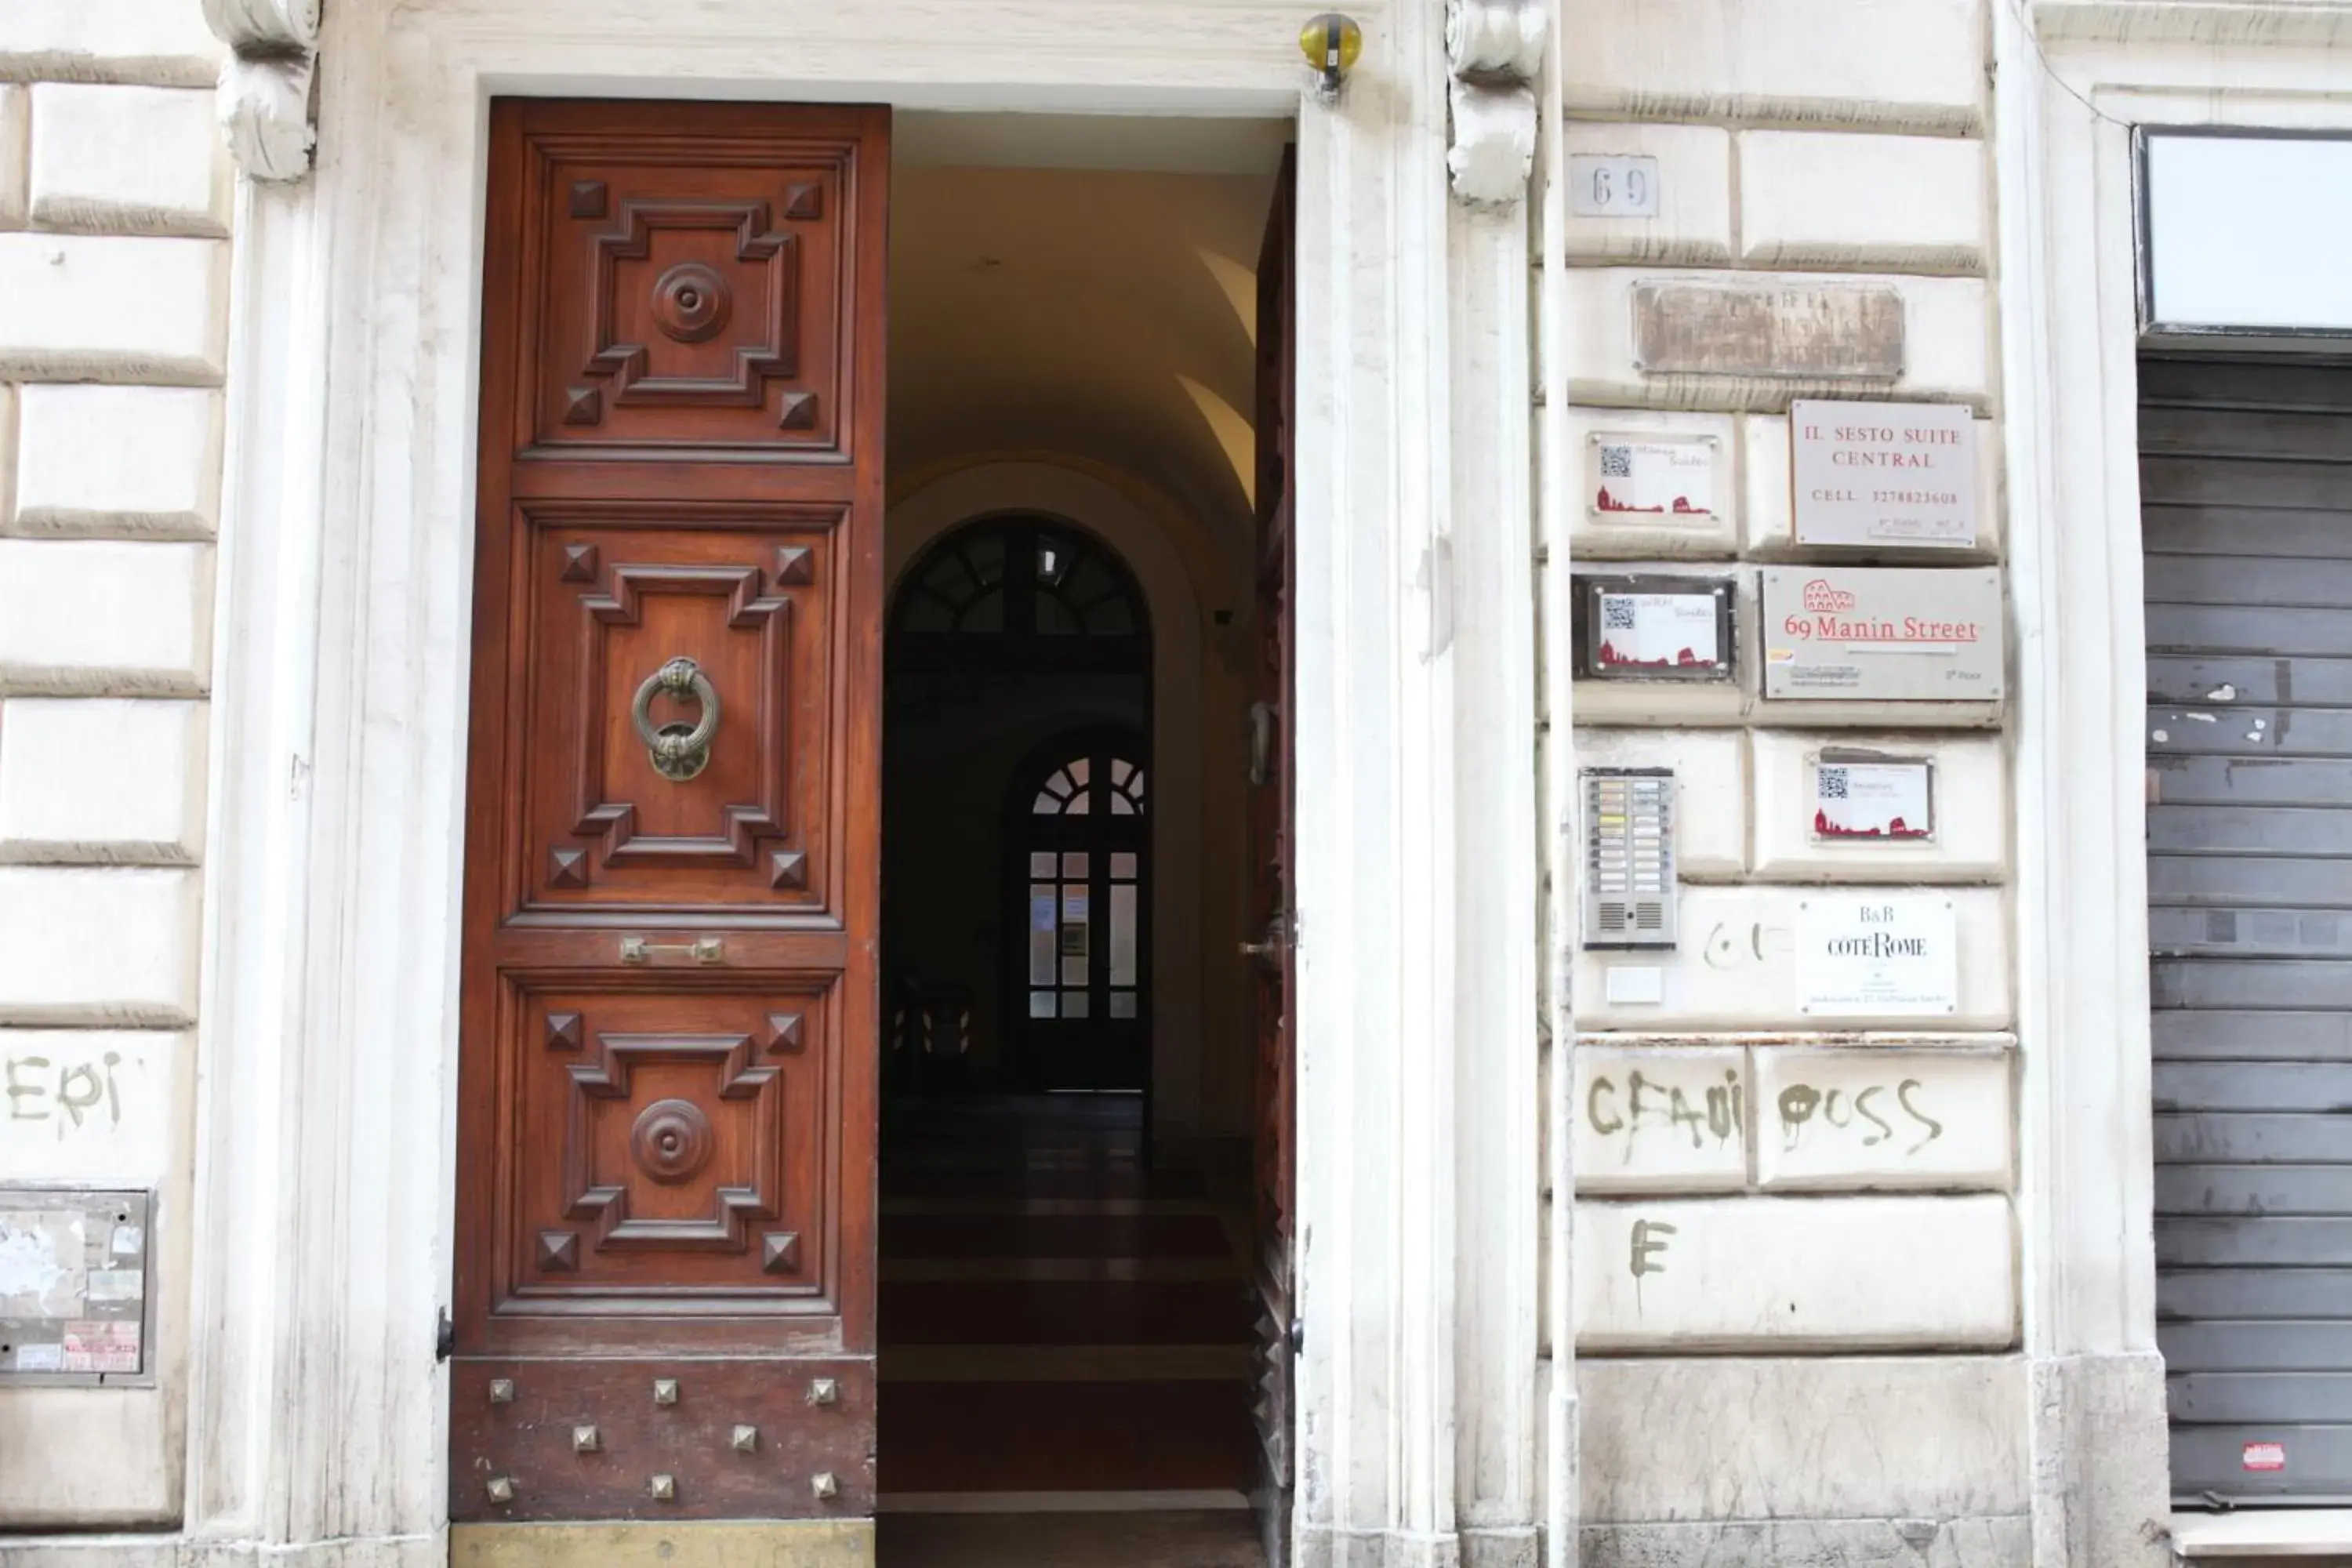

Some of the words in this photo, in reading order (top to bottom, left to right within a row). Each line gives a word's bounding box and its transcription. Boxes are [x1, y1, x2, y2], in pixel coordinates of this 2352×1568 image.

[1593, 167, 1646, 206] 69
[1805, 426, 1824, 440] IL
[1835, 426, 1893, 442] SESTO
[1904, 429, 1960, 445] SUITE
[1832, 452, 1935, 468] CENTRAL
[1784, 615, 1812, 640] 69
[1818, 616, 1895, 638] Manin
[1904, 617, 1979, 638] Street
